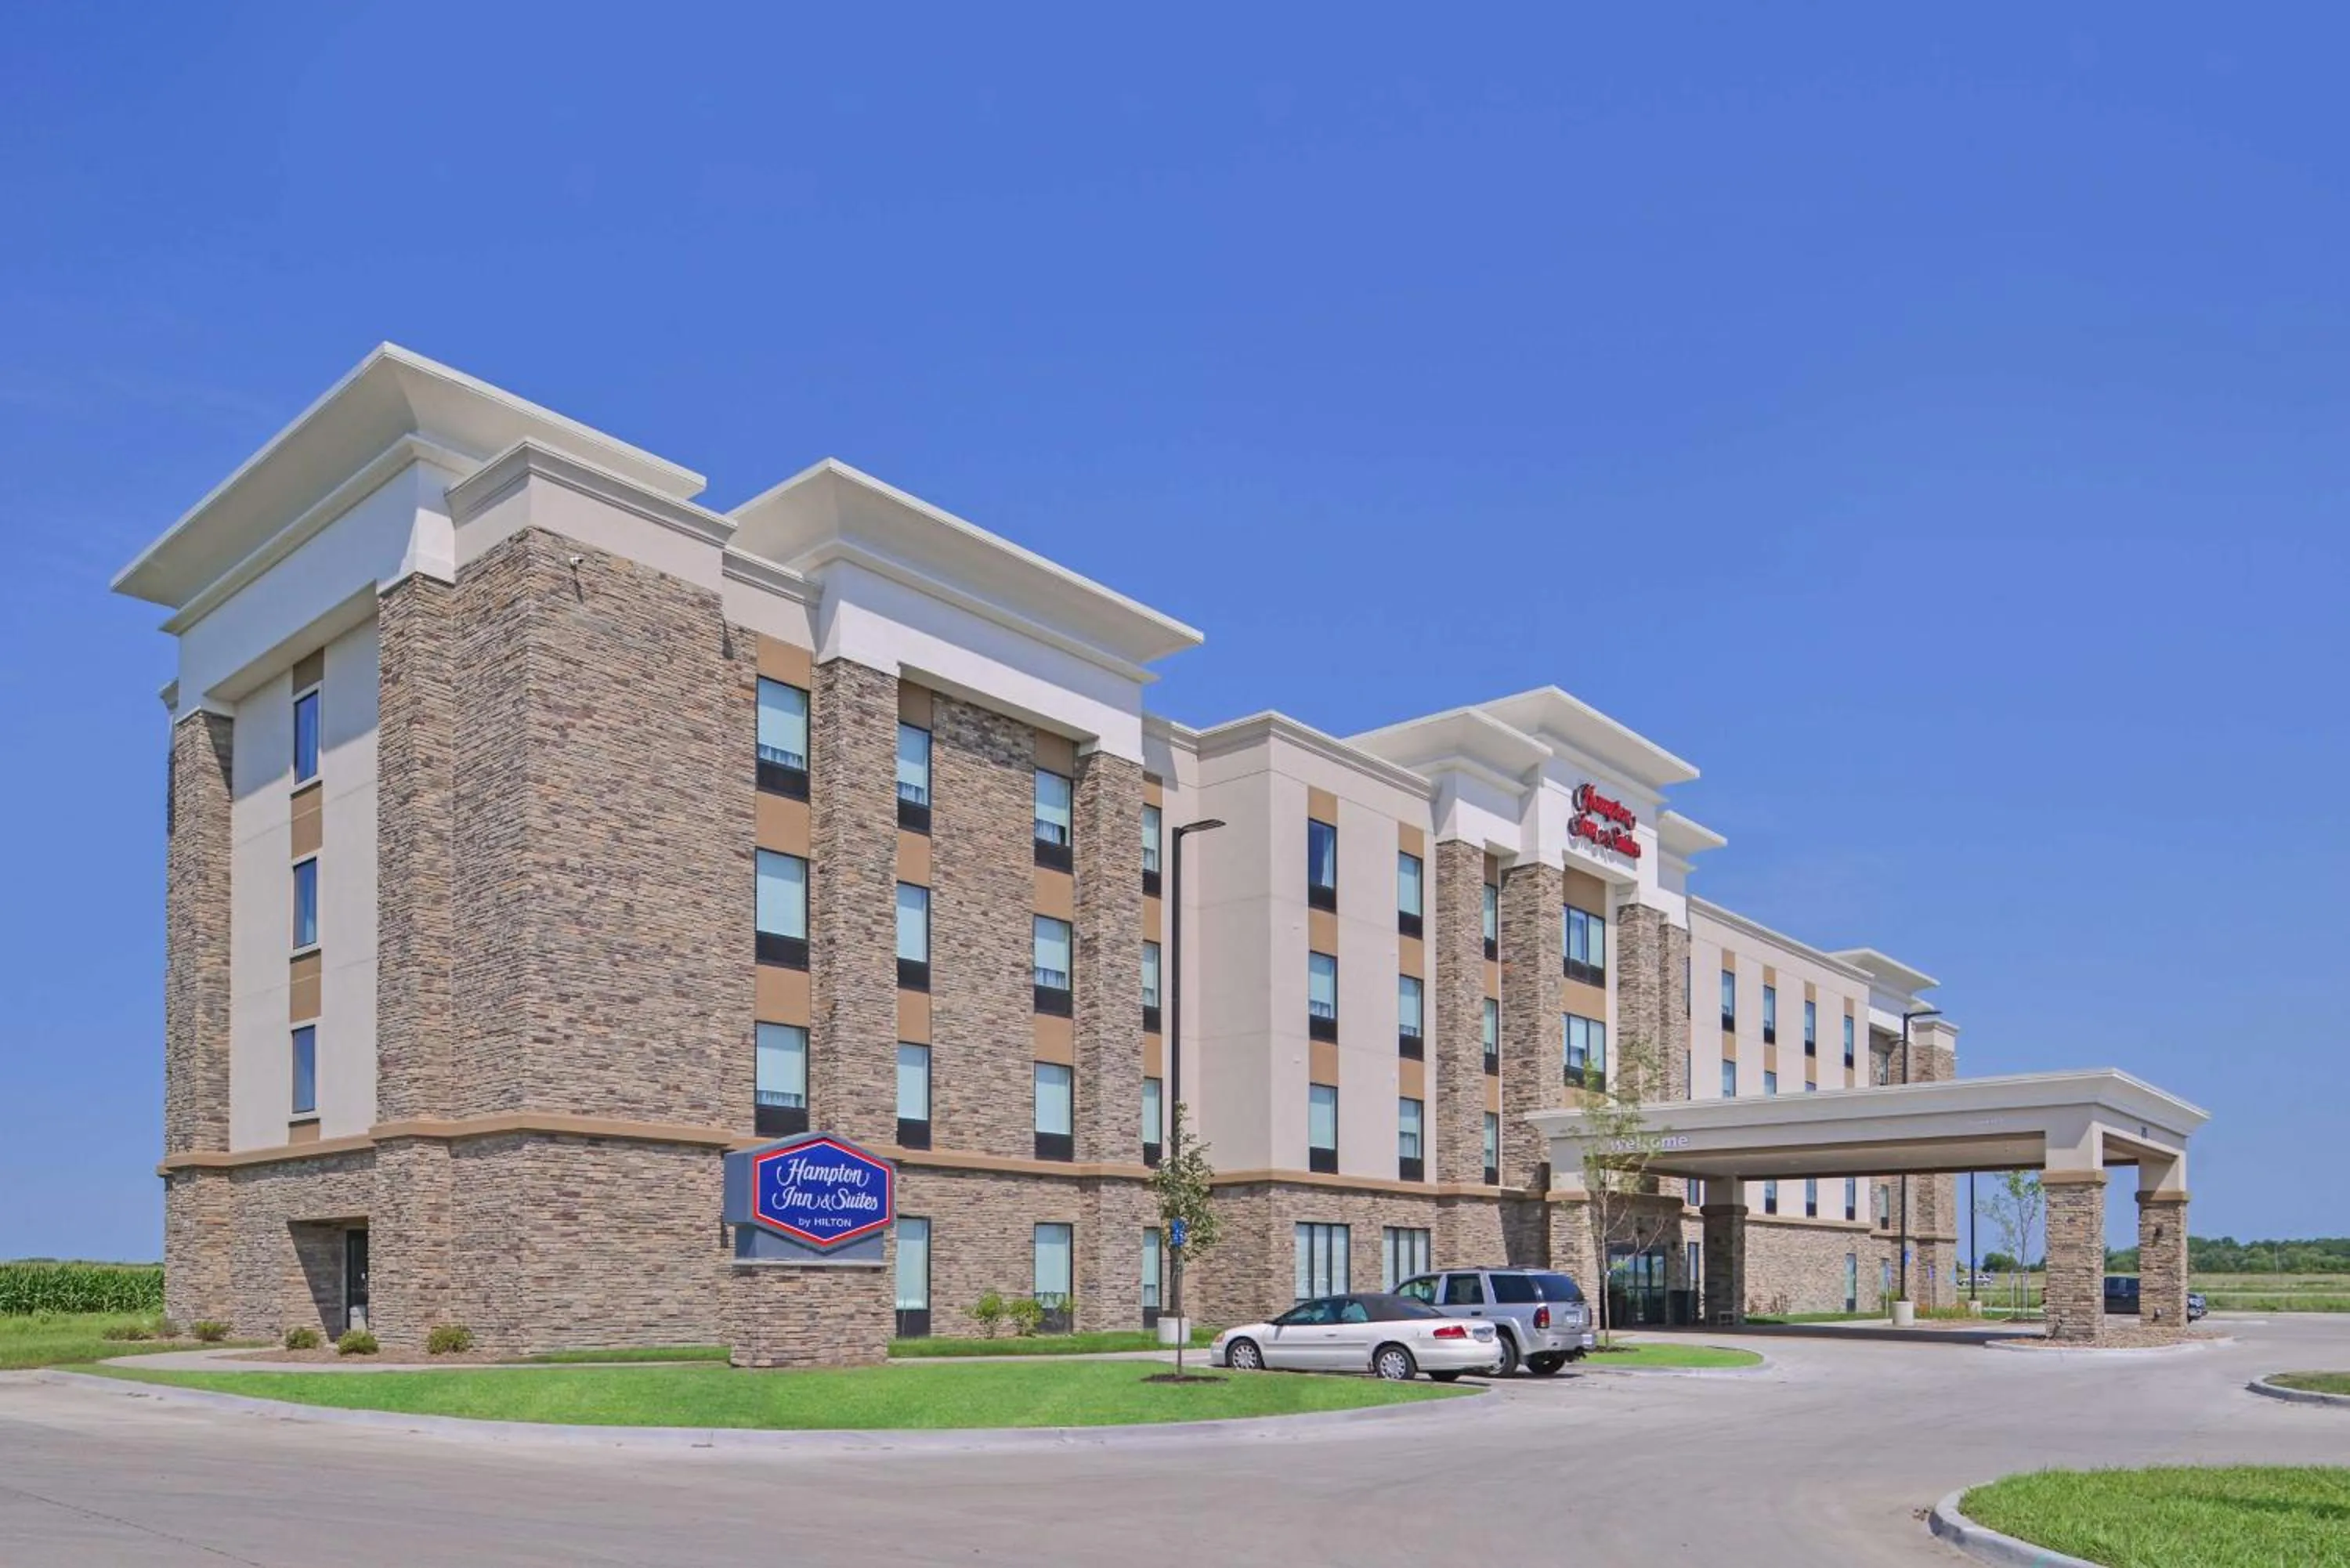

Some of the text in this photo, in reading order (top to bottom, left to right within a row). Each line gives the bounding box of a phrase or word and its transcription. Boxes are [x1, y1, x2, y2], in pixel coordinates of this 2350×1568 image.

[776, 1158, 870, 1187] Hampton
[772, 1186, 877, 1211] Inn & Suites
[798, 1218, 851, 1227] by HILTON
